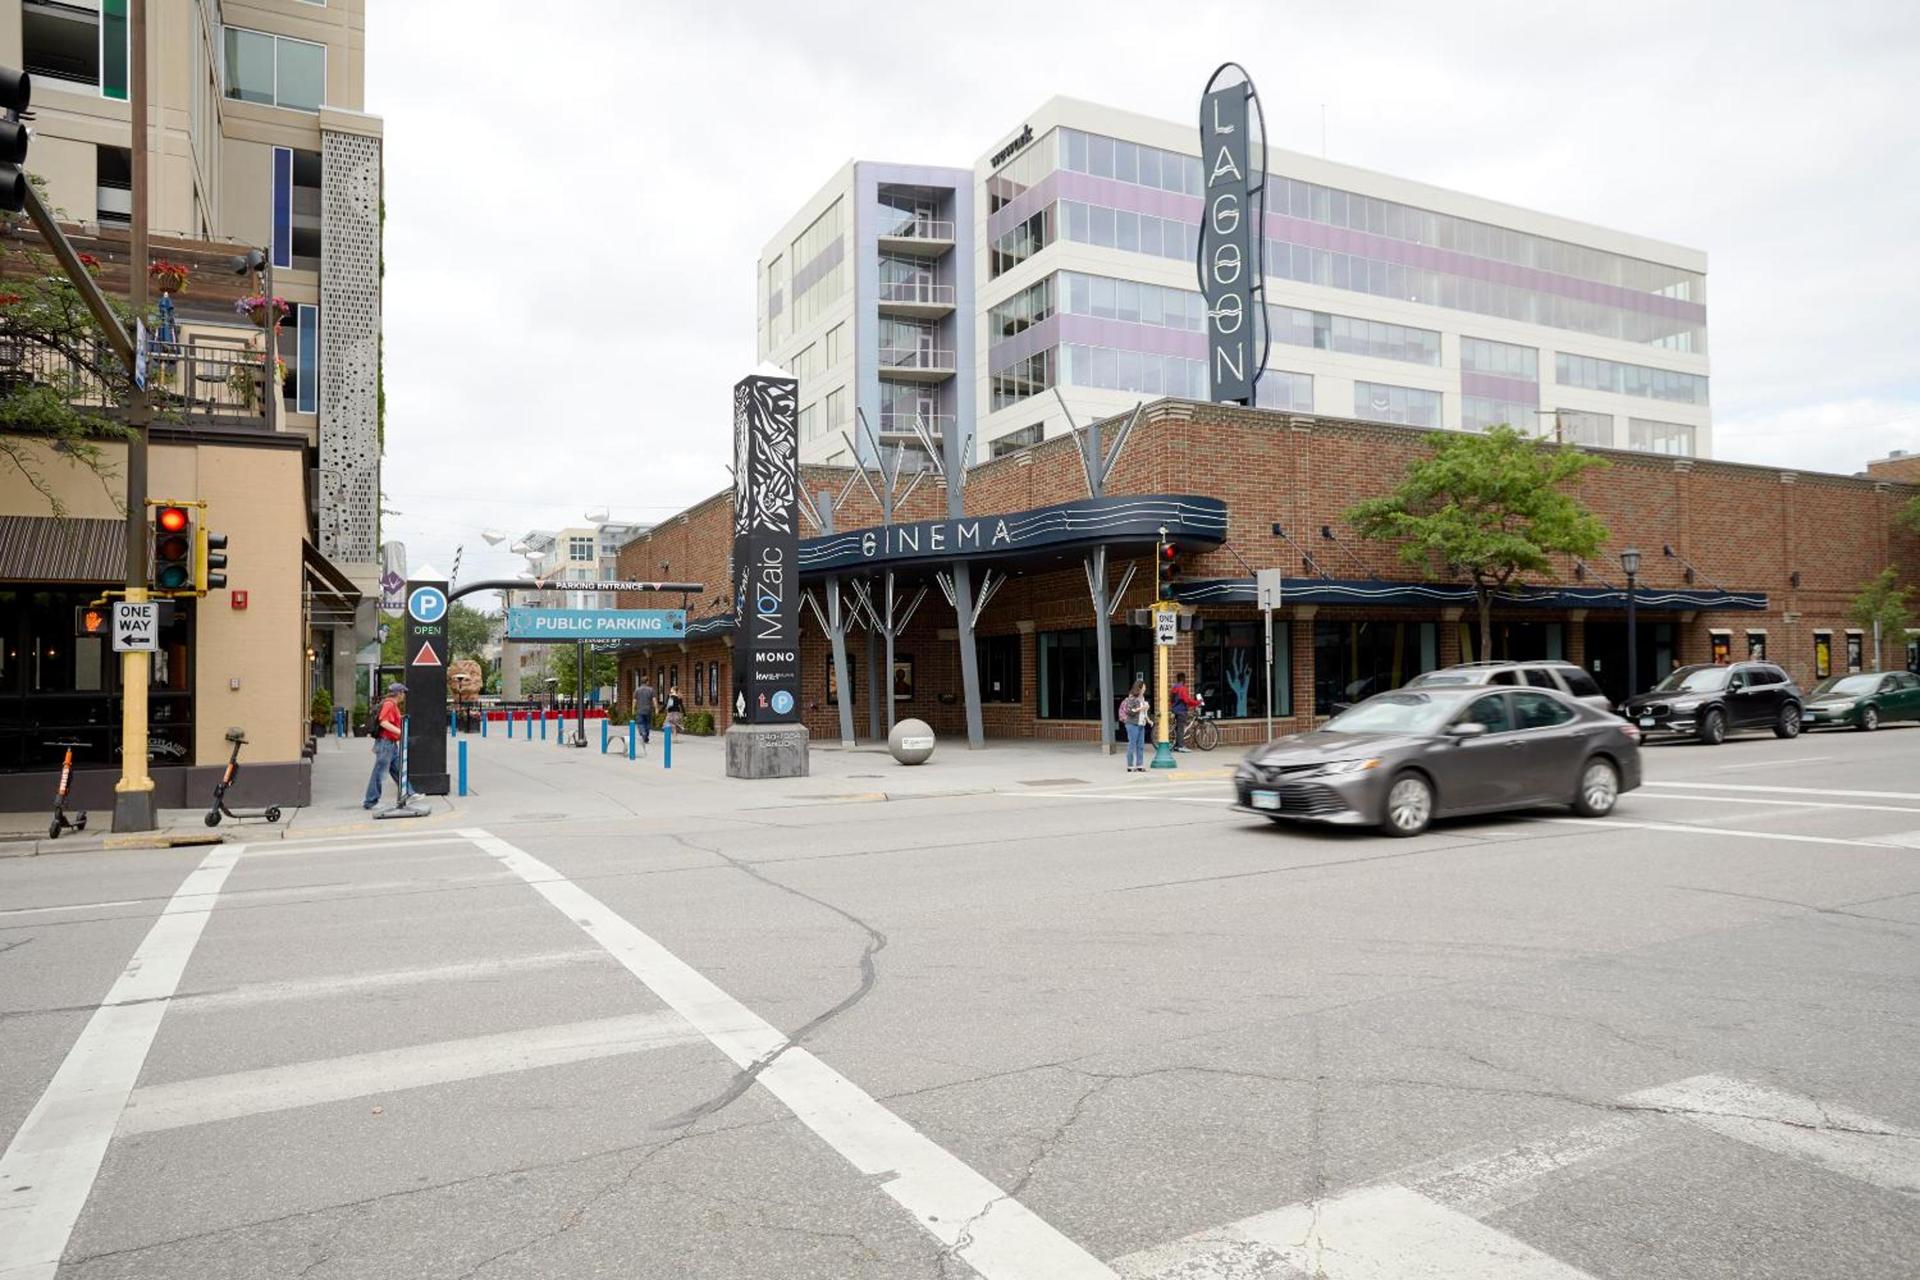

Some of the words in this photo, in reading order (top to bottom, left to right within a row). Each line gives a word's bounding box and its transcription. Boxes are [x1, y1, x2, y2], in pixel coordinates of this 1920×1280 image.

[1208, 99, 1243, 384] LAGOON
[862, 519, 1011, 557] CINEMA
[556, 582, 595, 591] PARKING
[597, 583, 643, 591] ENTRANCE
[420, 595, 437, 615] P
[120, 606, 151, 618] ONE
[119, 620, 151, 631] WAY
[535, 617, 592, 630] PUBLIC
[596, 617, 661, 630] PARKING
[414, 626, 441, 635] OPEN
[755, 652, 795, 662] MONO
